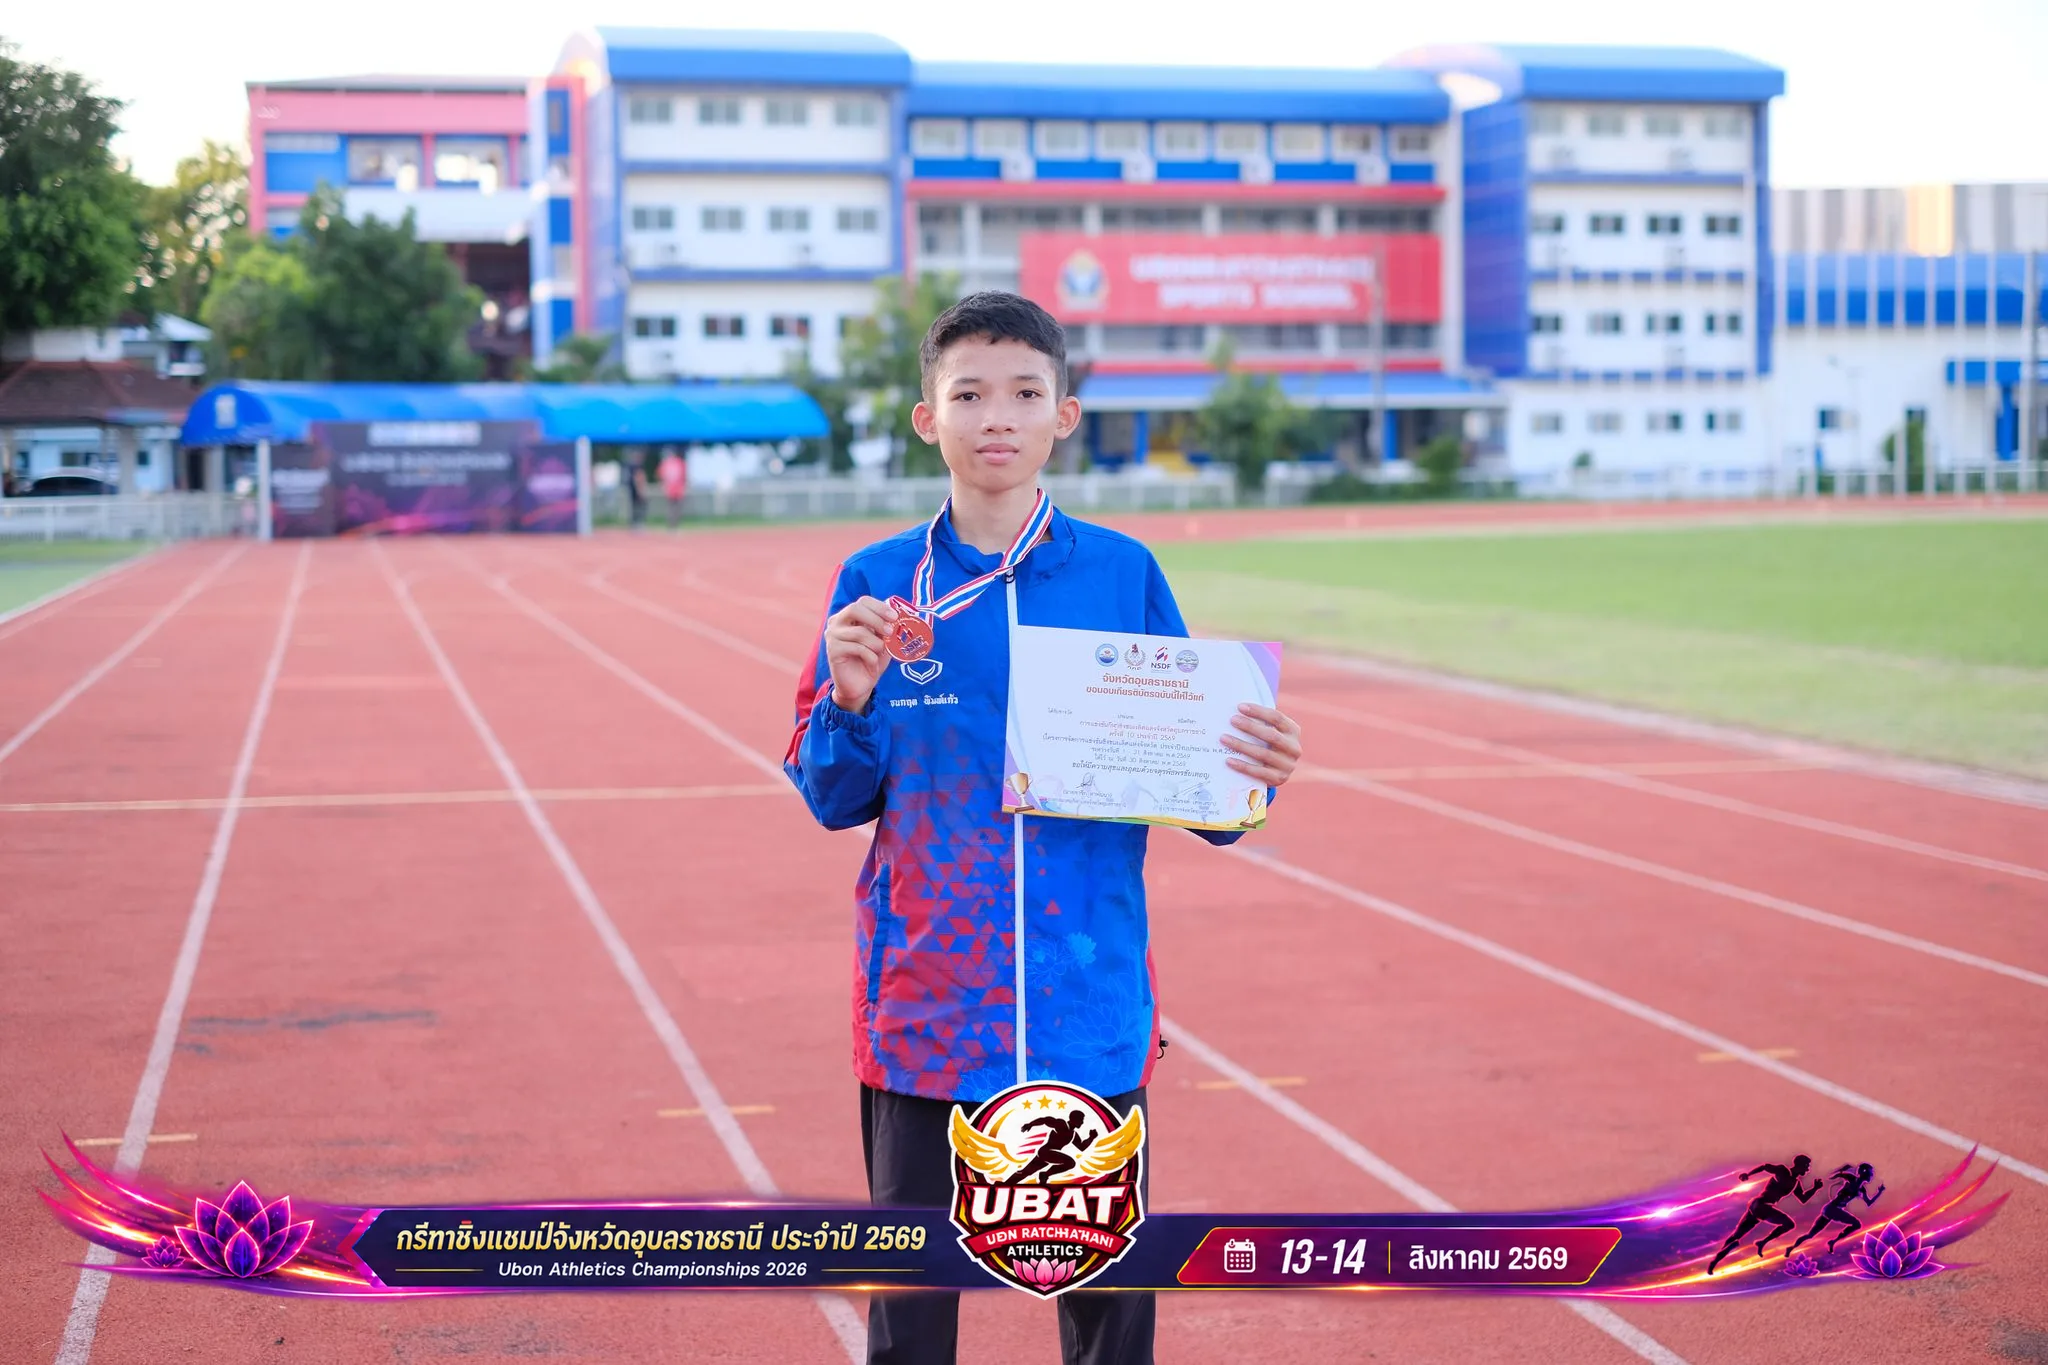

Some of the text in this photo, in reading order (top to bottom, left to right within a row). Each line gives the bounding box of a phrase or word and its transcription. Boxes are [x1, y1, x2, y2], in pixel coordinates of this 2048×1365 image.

[1151, 662, 1172, 670] NSDF
[1102, 673, 1189, 689] จังหวัดอุบลราชธานี
[1086, 686, 1204, 702] ขอมอบเกียรติบัตรฉบับนี้ให้ไว้แก่
